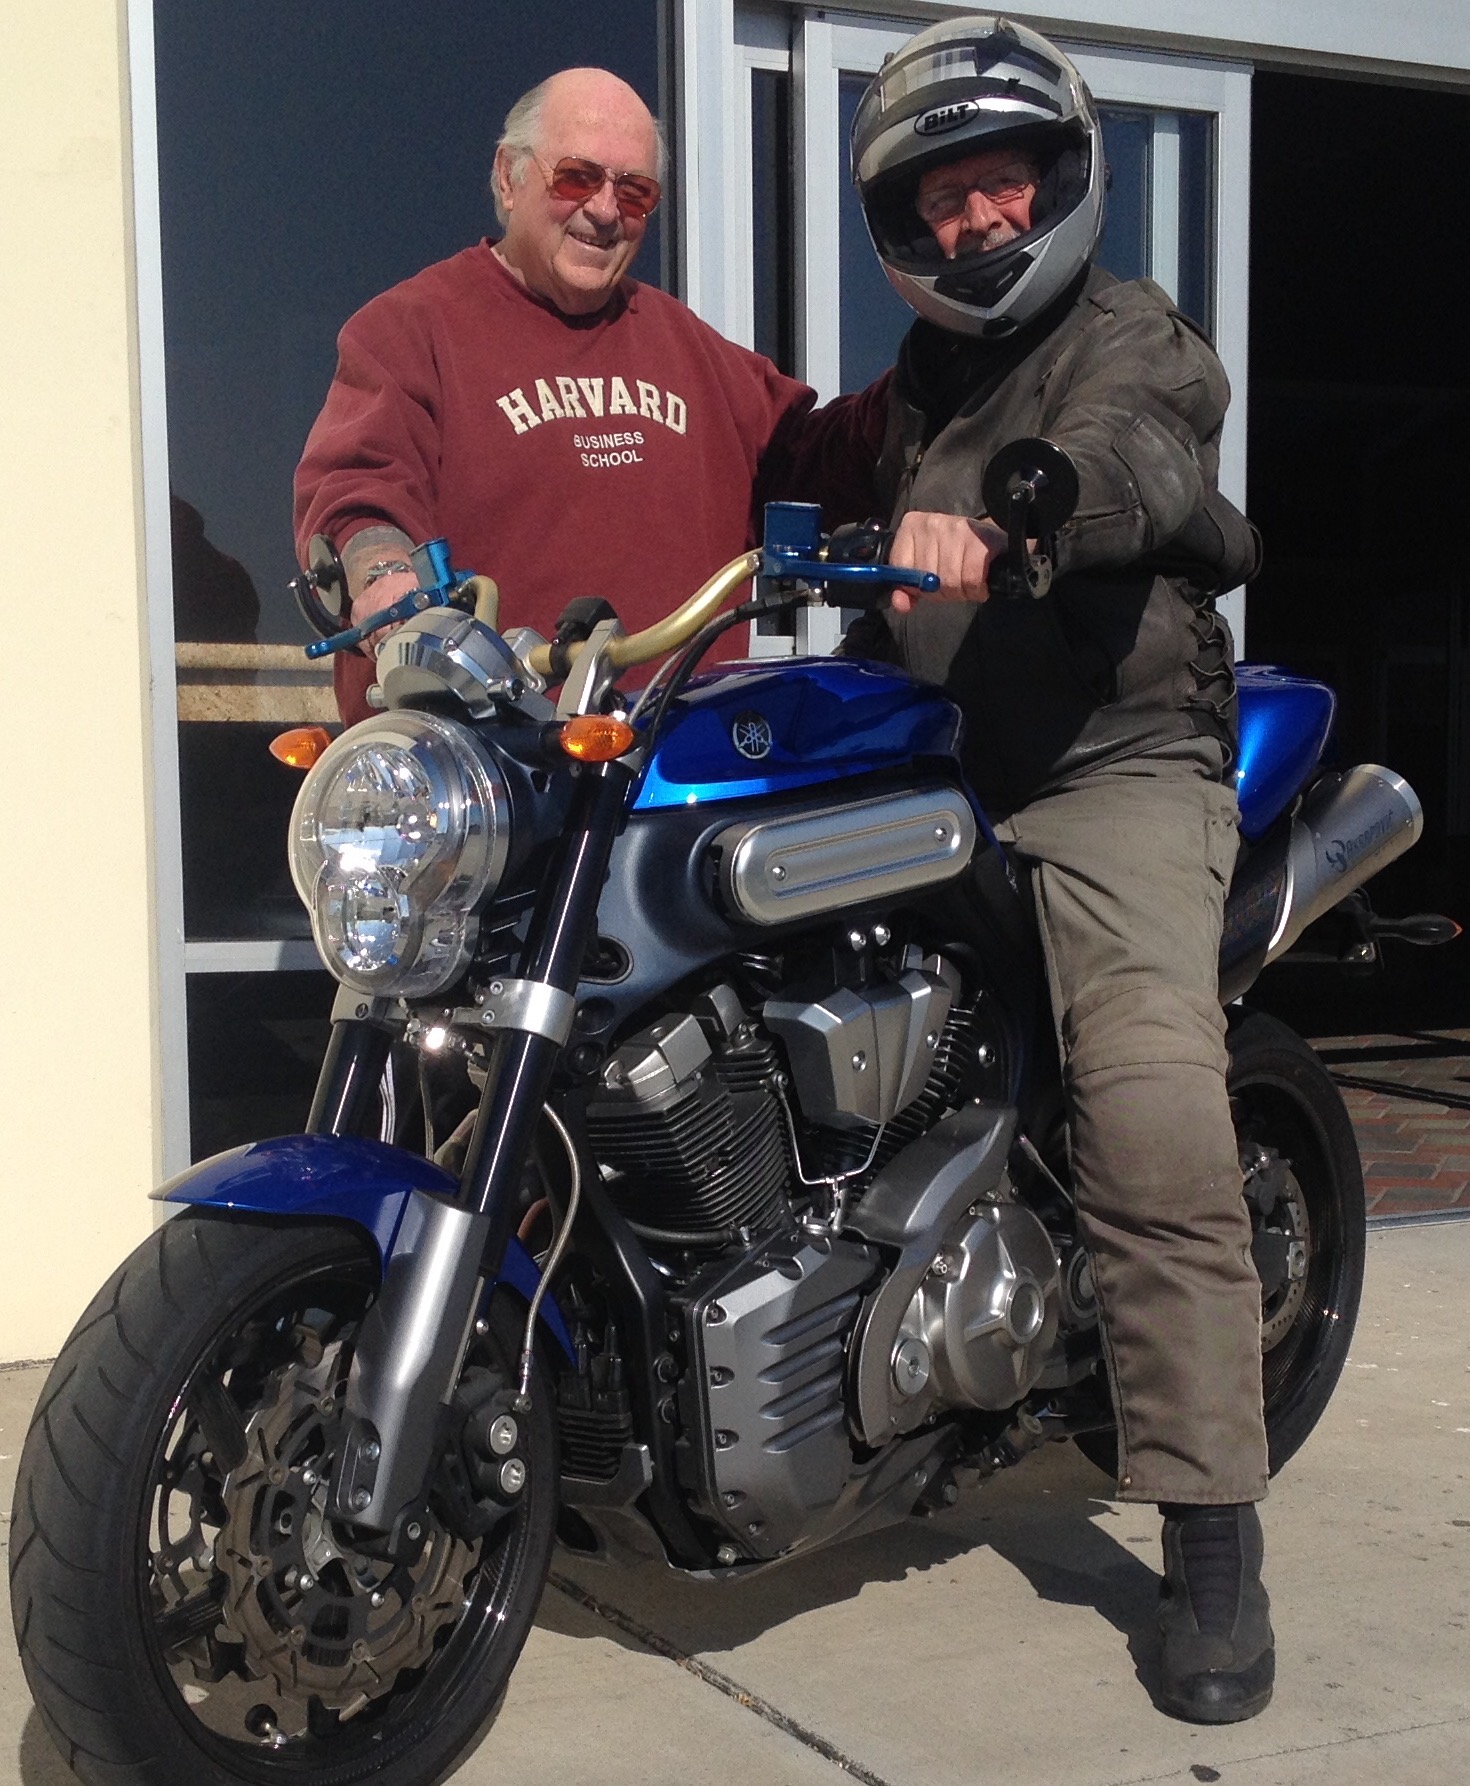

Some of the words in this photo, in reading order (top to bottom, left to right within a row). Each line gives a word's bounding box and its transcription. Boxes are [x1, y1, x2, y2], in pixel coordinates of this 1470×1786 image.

[496, 376, 687, 435] HARVARD
[573, 431, 645, 449] BUSINESS
[580, 450, 644, 467] SCHOOL
